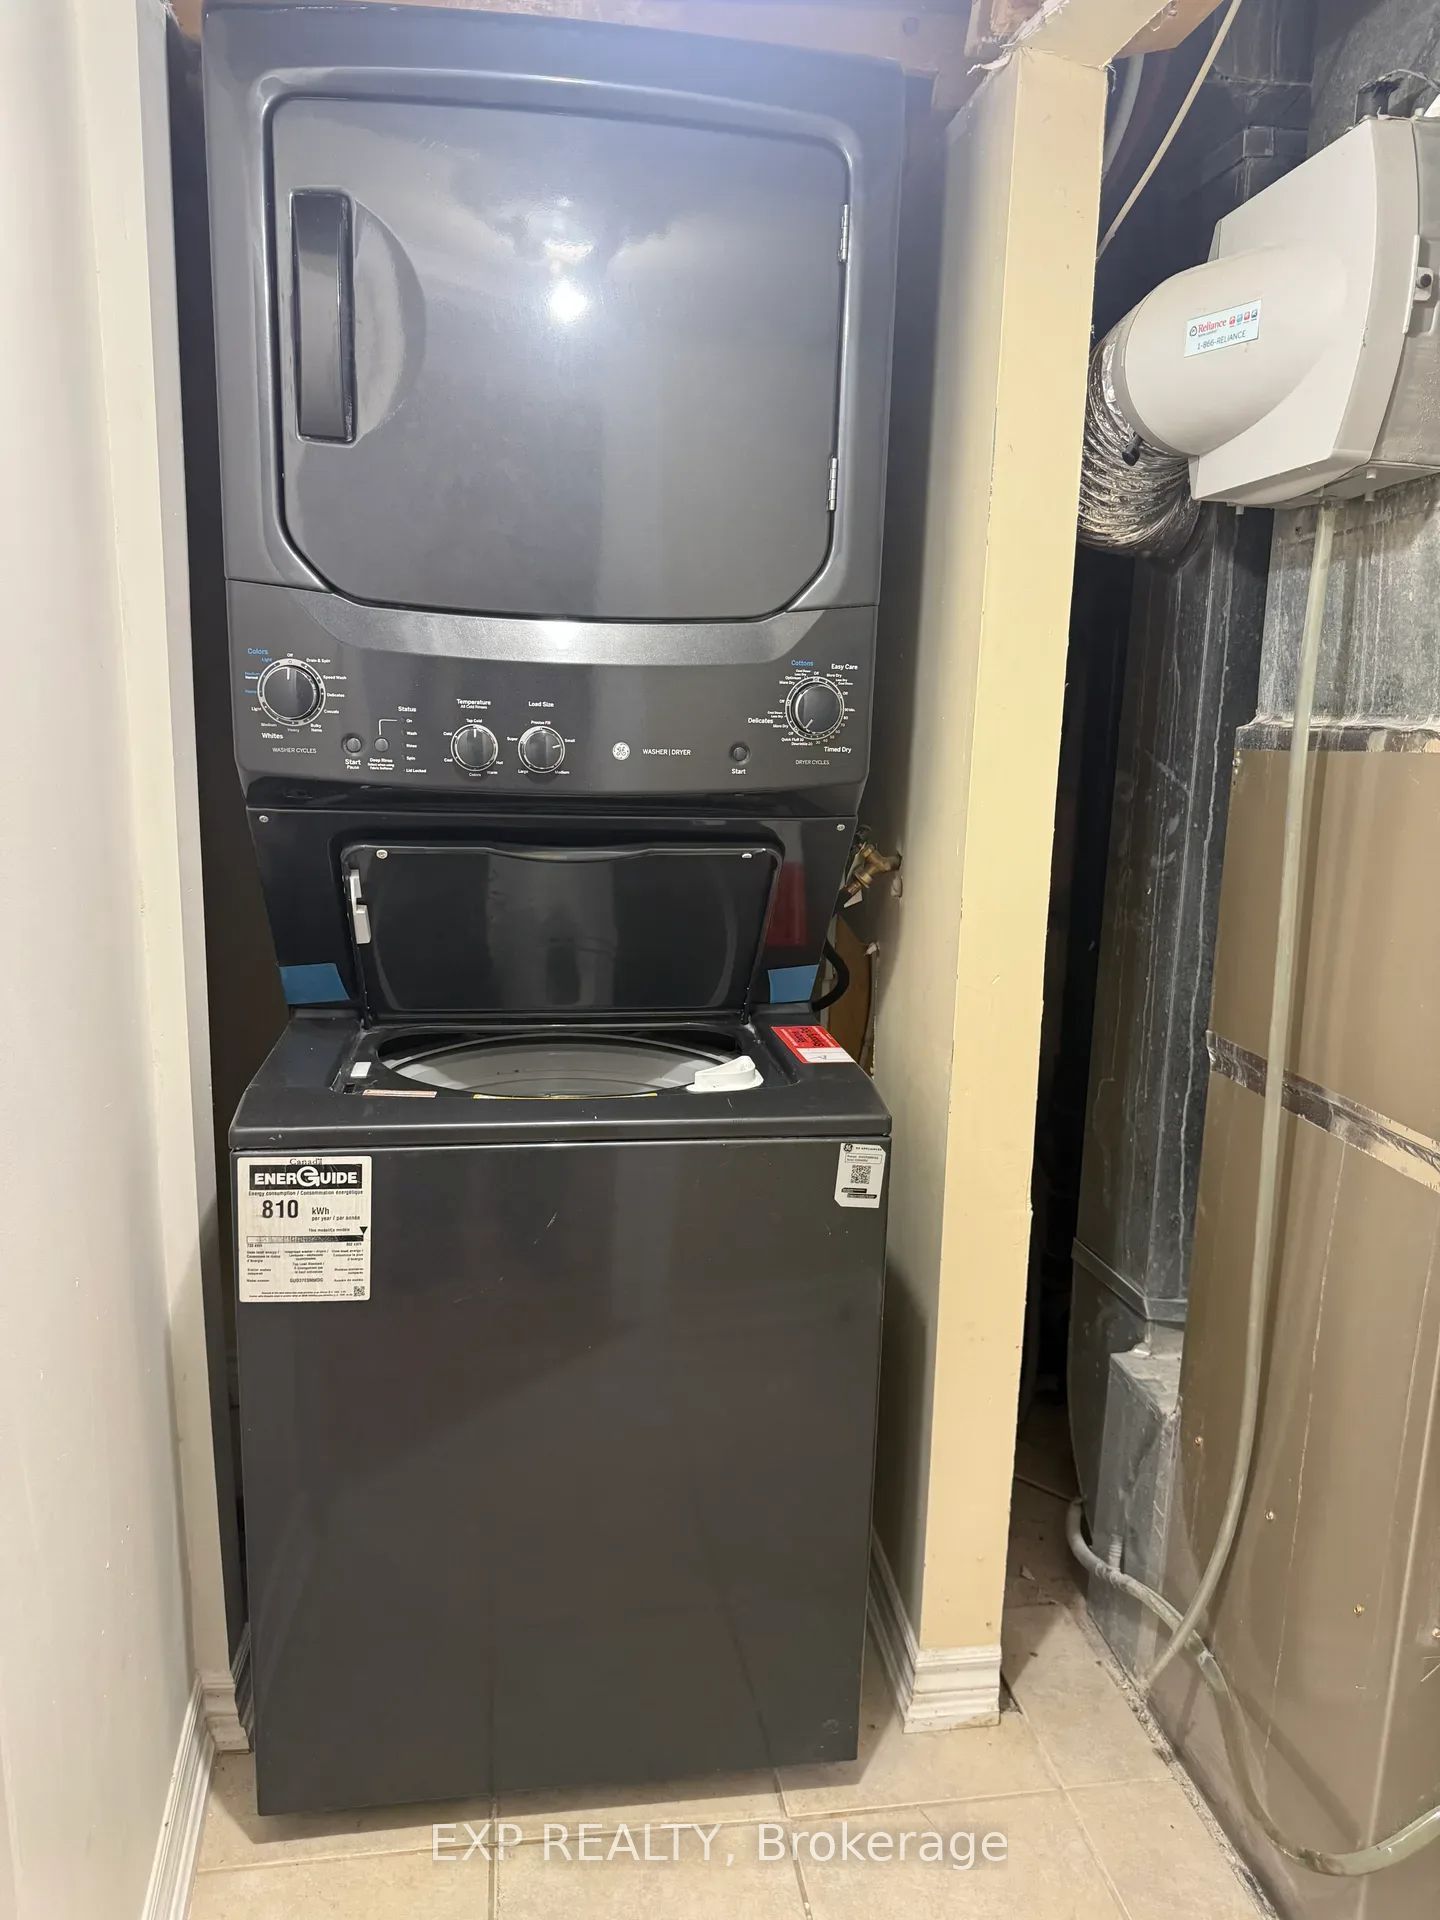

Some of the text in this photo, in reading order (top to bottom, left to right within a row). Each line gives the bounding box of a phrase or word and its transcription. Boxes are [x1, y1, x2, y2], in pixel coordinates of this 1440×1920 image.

[1198, 320, 1226, 333] Reliance
[1197, 330, 1246, 350] 1-866-RELIANCE
[254, 1166, 358, 1187] ENERGUIDE
[262, 1200, 299, 1218] 810
